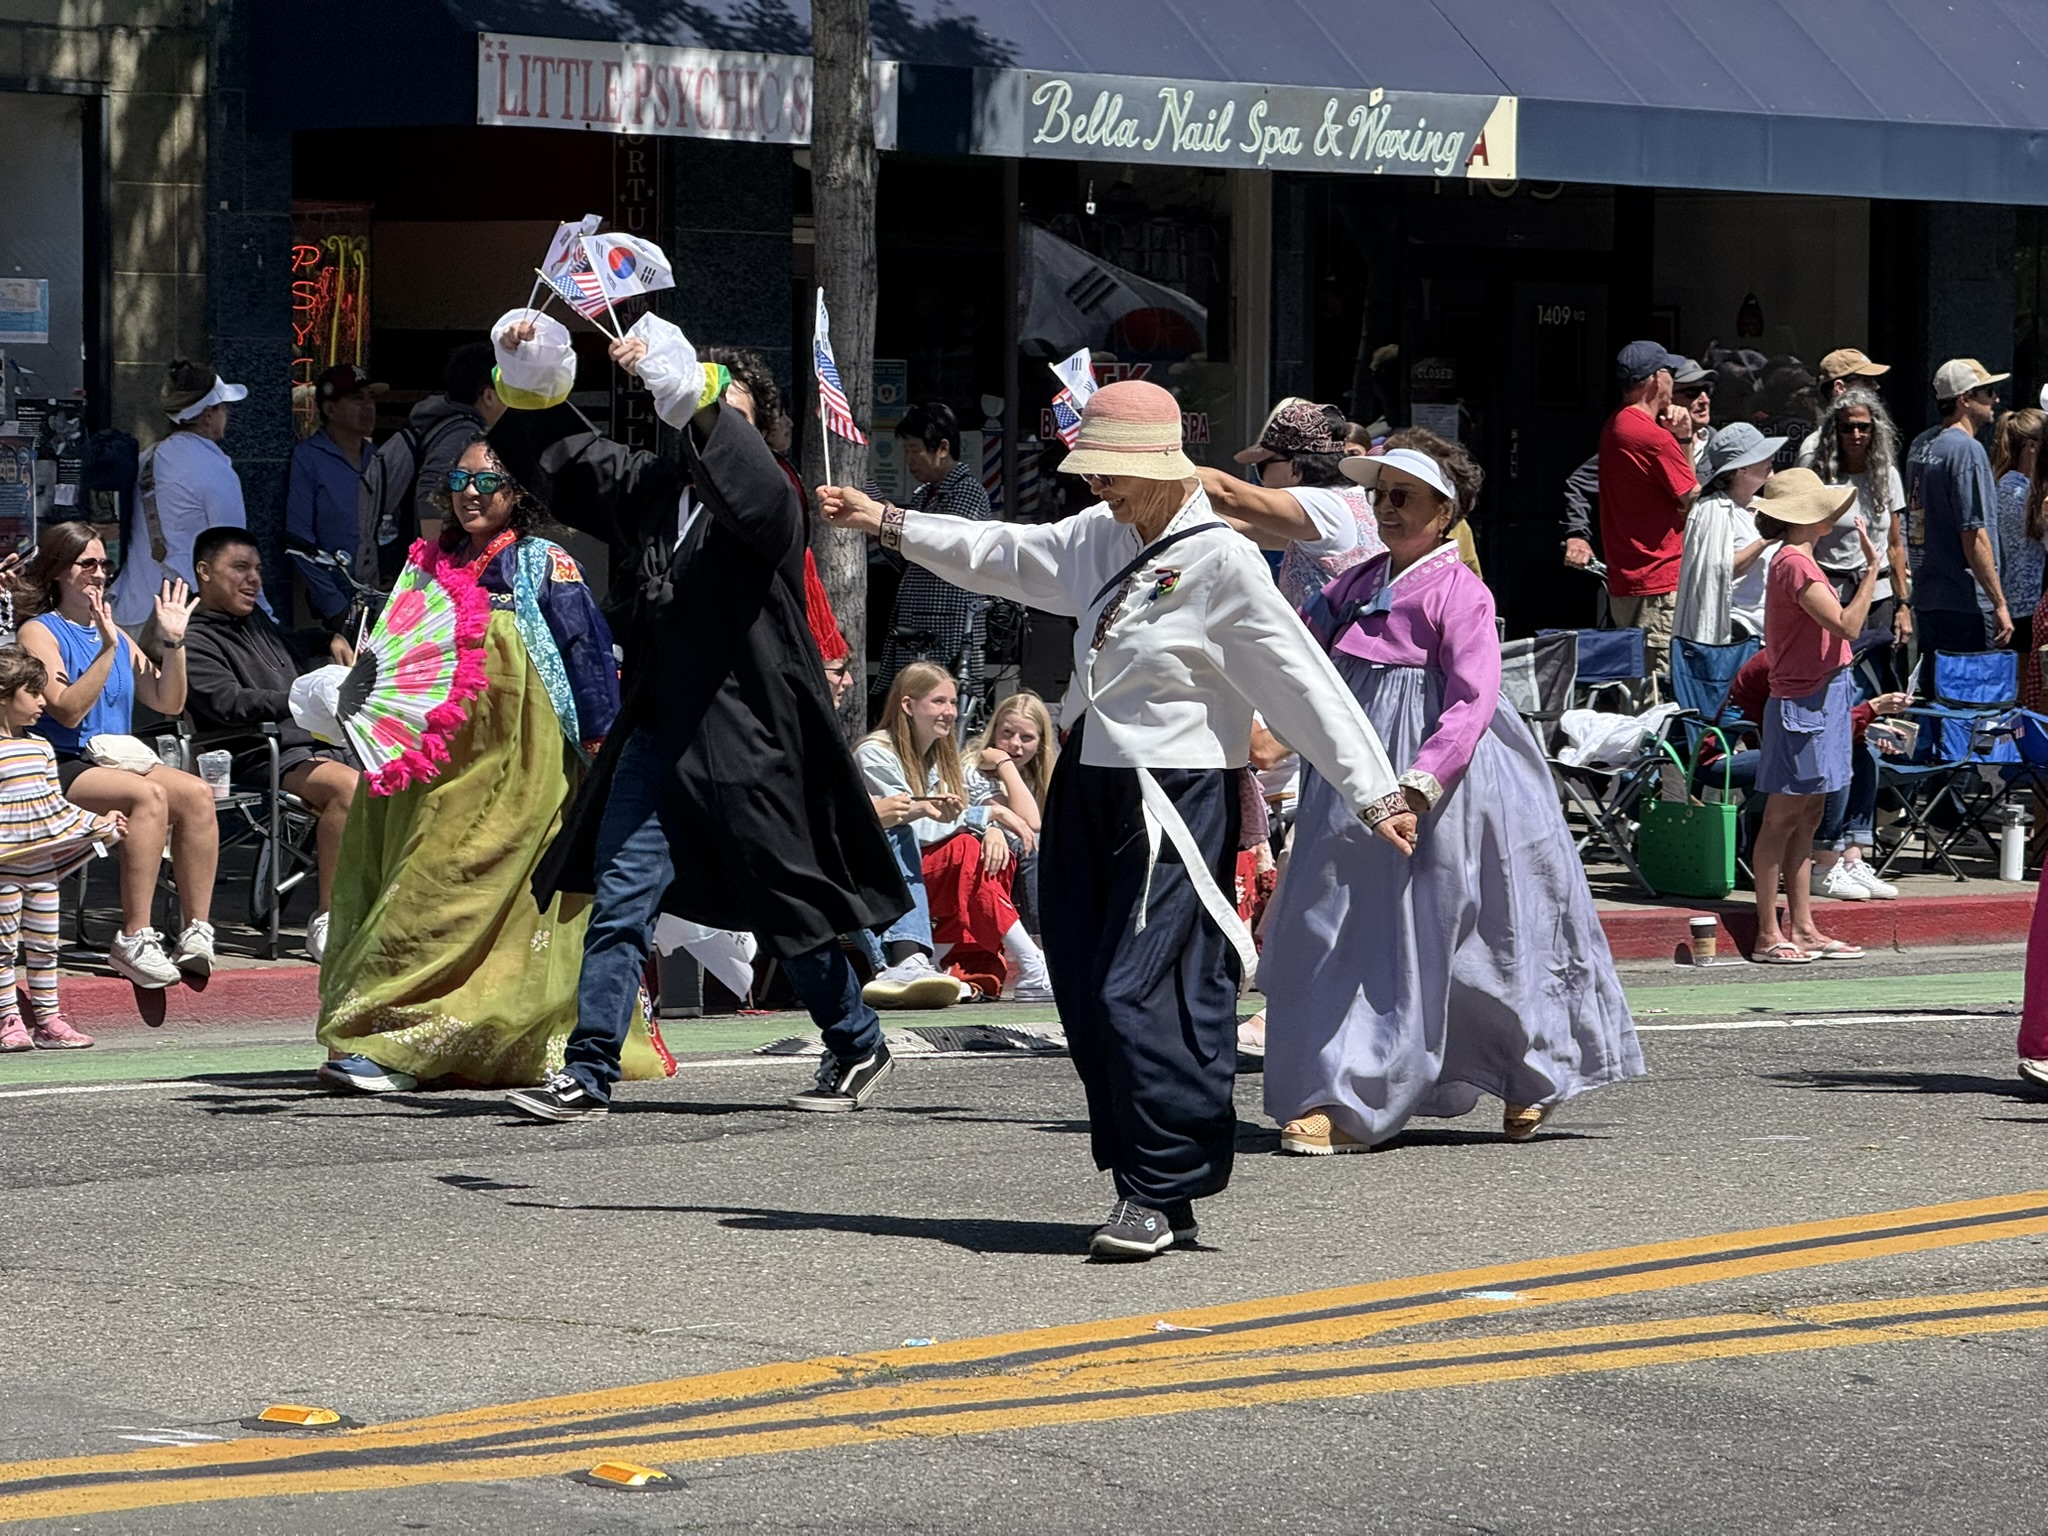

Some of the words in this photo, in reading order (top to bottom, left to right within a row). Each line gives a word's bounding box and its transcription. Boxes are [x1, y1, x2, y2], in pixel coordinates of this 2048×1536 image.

[496, 52, 622, 124] LITTLE
[632, 61, 781, 134] PSYCHIC
[1032, 79, 1140, 148] Bella
[1142, 87, 1235, 152] Nail
[1239, 99, 1303, 165] Spa
[1313, 97, 1344, 156] &
[1347, 103, 1465, 176] Waxing
[1536, 305, 1571, 325] 1409
[1417, 367, 1454, 380] CLOSED
